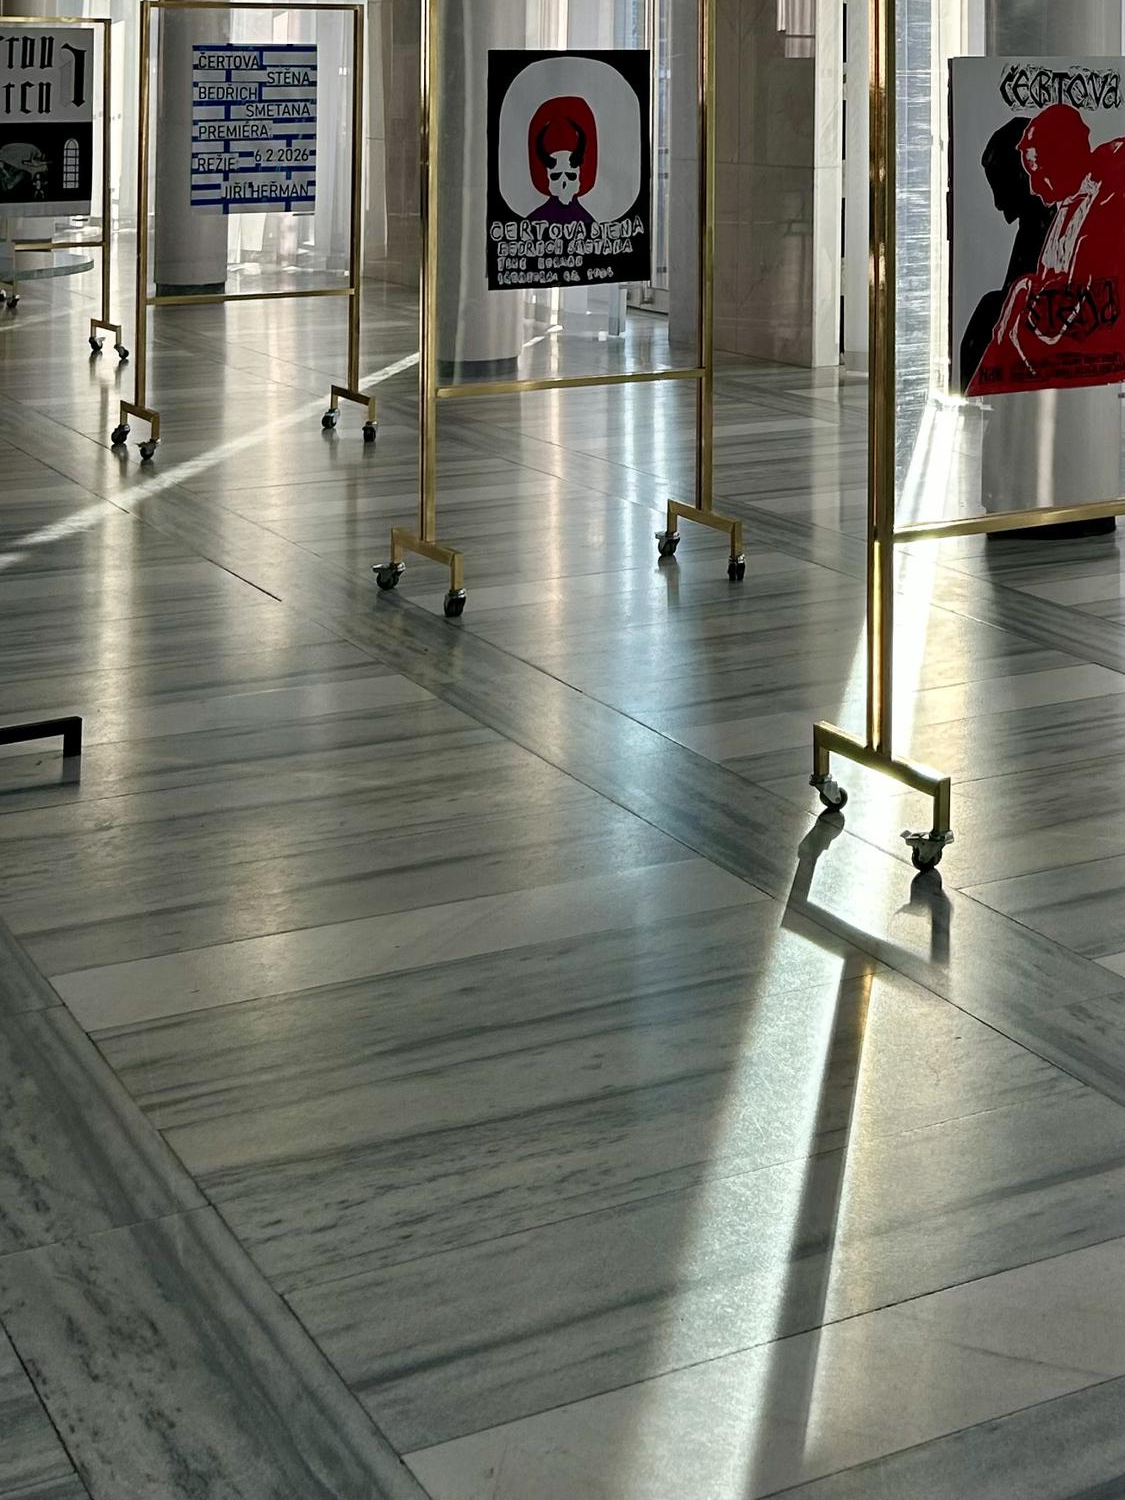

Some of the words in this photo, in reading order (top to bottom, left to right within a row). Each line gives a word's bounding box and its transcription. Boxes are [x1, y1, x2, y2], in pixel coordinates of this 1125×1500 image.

[199, 53, 259, 68] ČERTOVA
[267, 68, 310, 84] STĚNA
[198, 84, 257, 99] BEDŘICH
[246, 104, 310, 117] SMETANA
[251, 181, 309, 198] HEŘMAN
